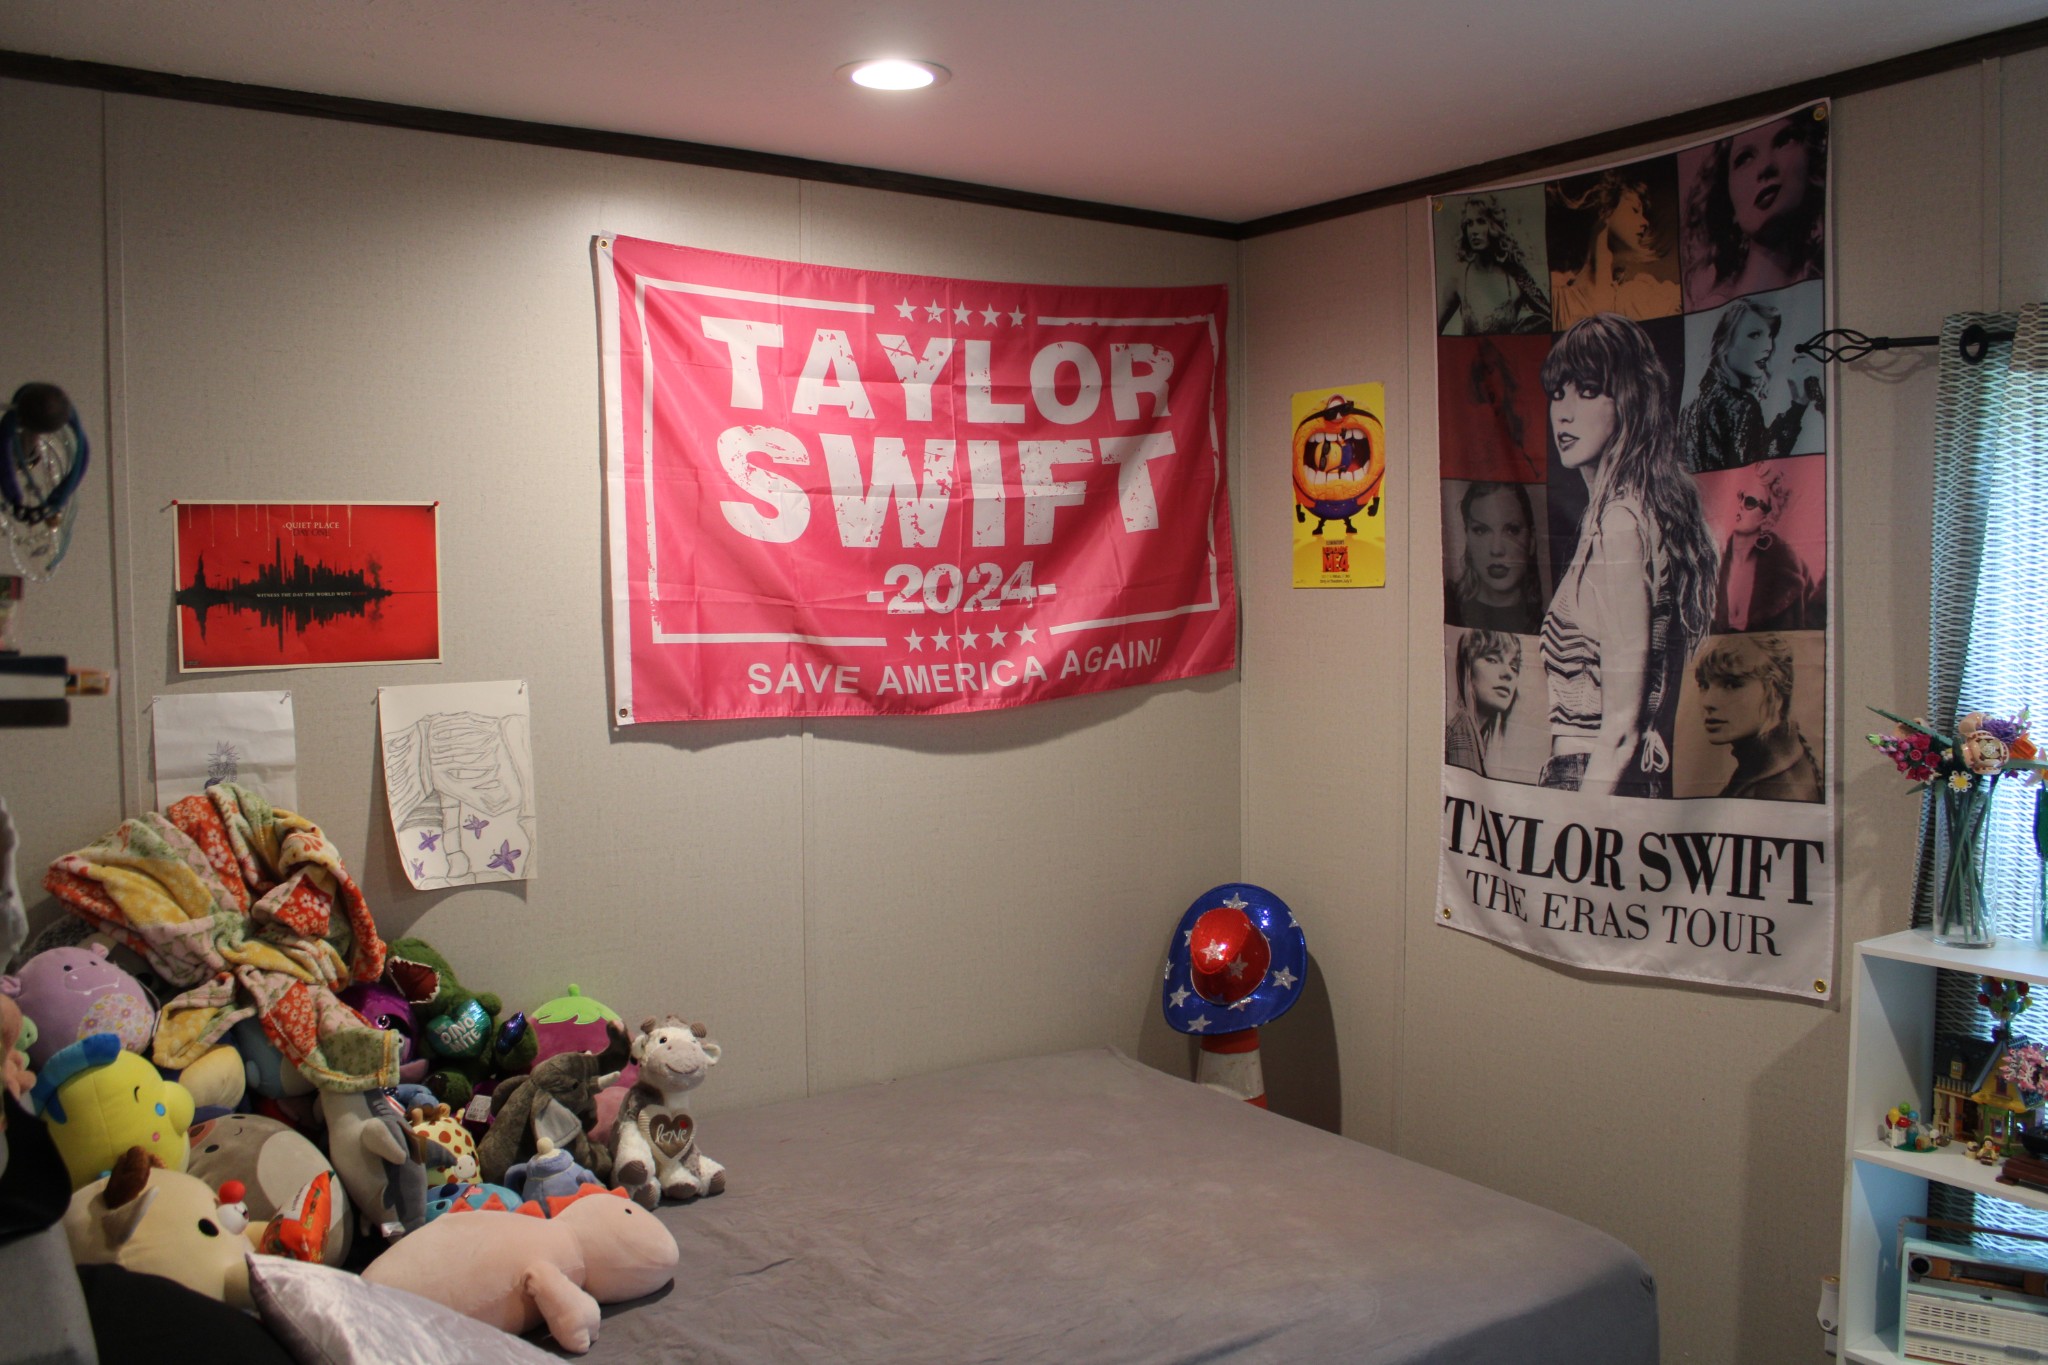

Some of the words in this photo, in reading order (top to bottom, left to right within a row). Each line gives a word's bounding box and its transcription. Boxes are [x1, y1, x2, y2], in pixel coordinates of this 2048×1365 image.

[701, 315, 1175, 424] TAYLOR
[285, 521, 311, 531] QUIET
[313, 521, 340, 529] PLACE
[717, 425, 1177, 548] SWIFT
[748, 664, 860, 695] SAVE
[876, 662, 1048, 696] AMERICA
[1060, 637, 1162, 679] AGAIN!
[1445, 796, 1625, 891] TAYLOR
[1638, 831, 1825, 906] SWIFT
[1466, 869, 1528, 923] THE
[1541, 892, 1650, 941] ERAS
[1662, 905, 1782, 957] TOUR
